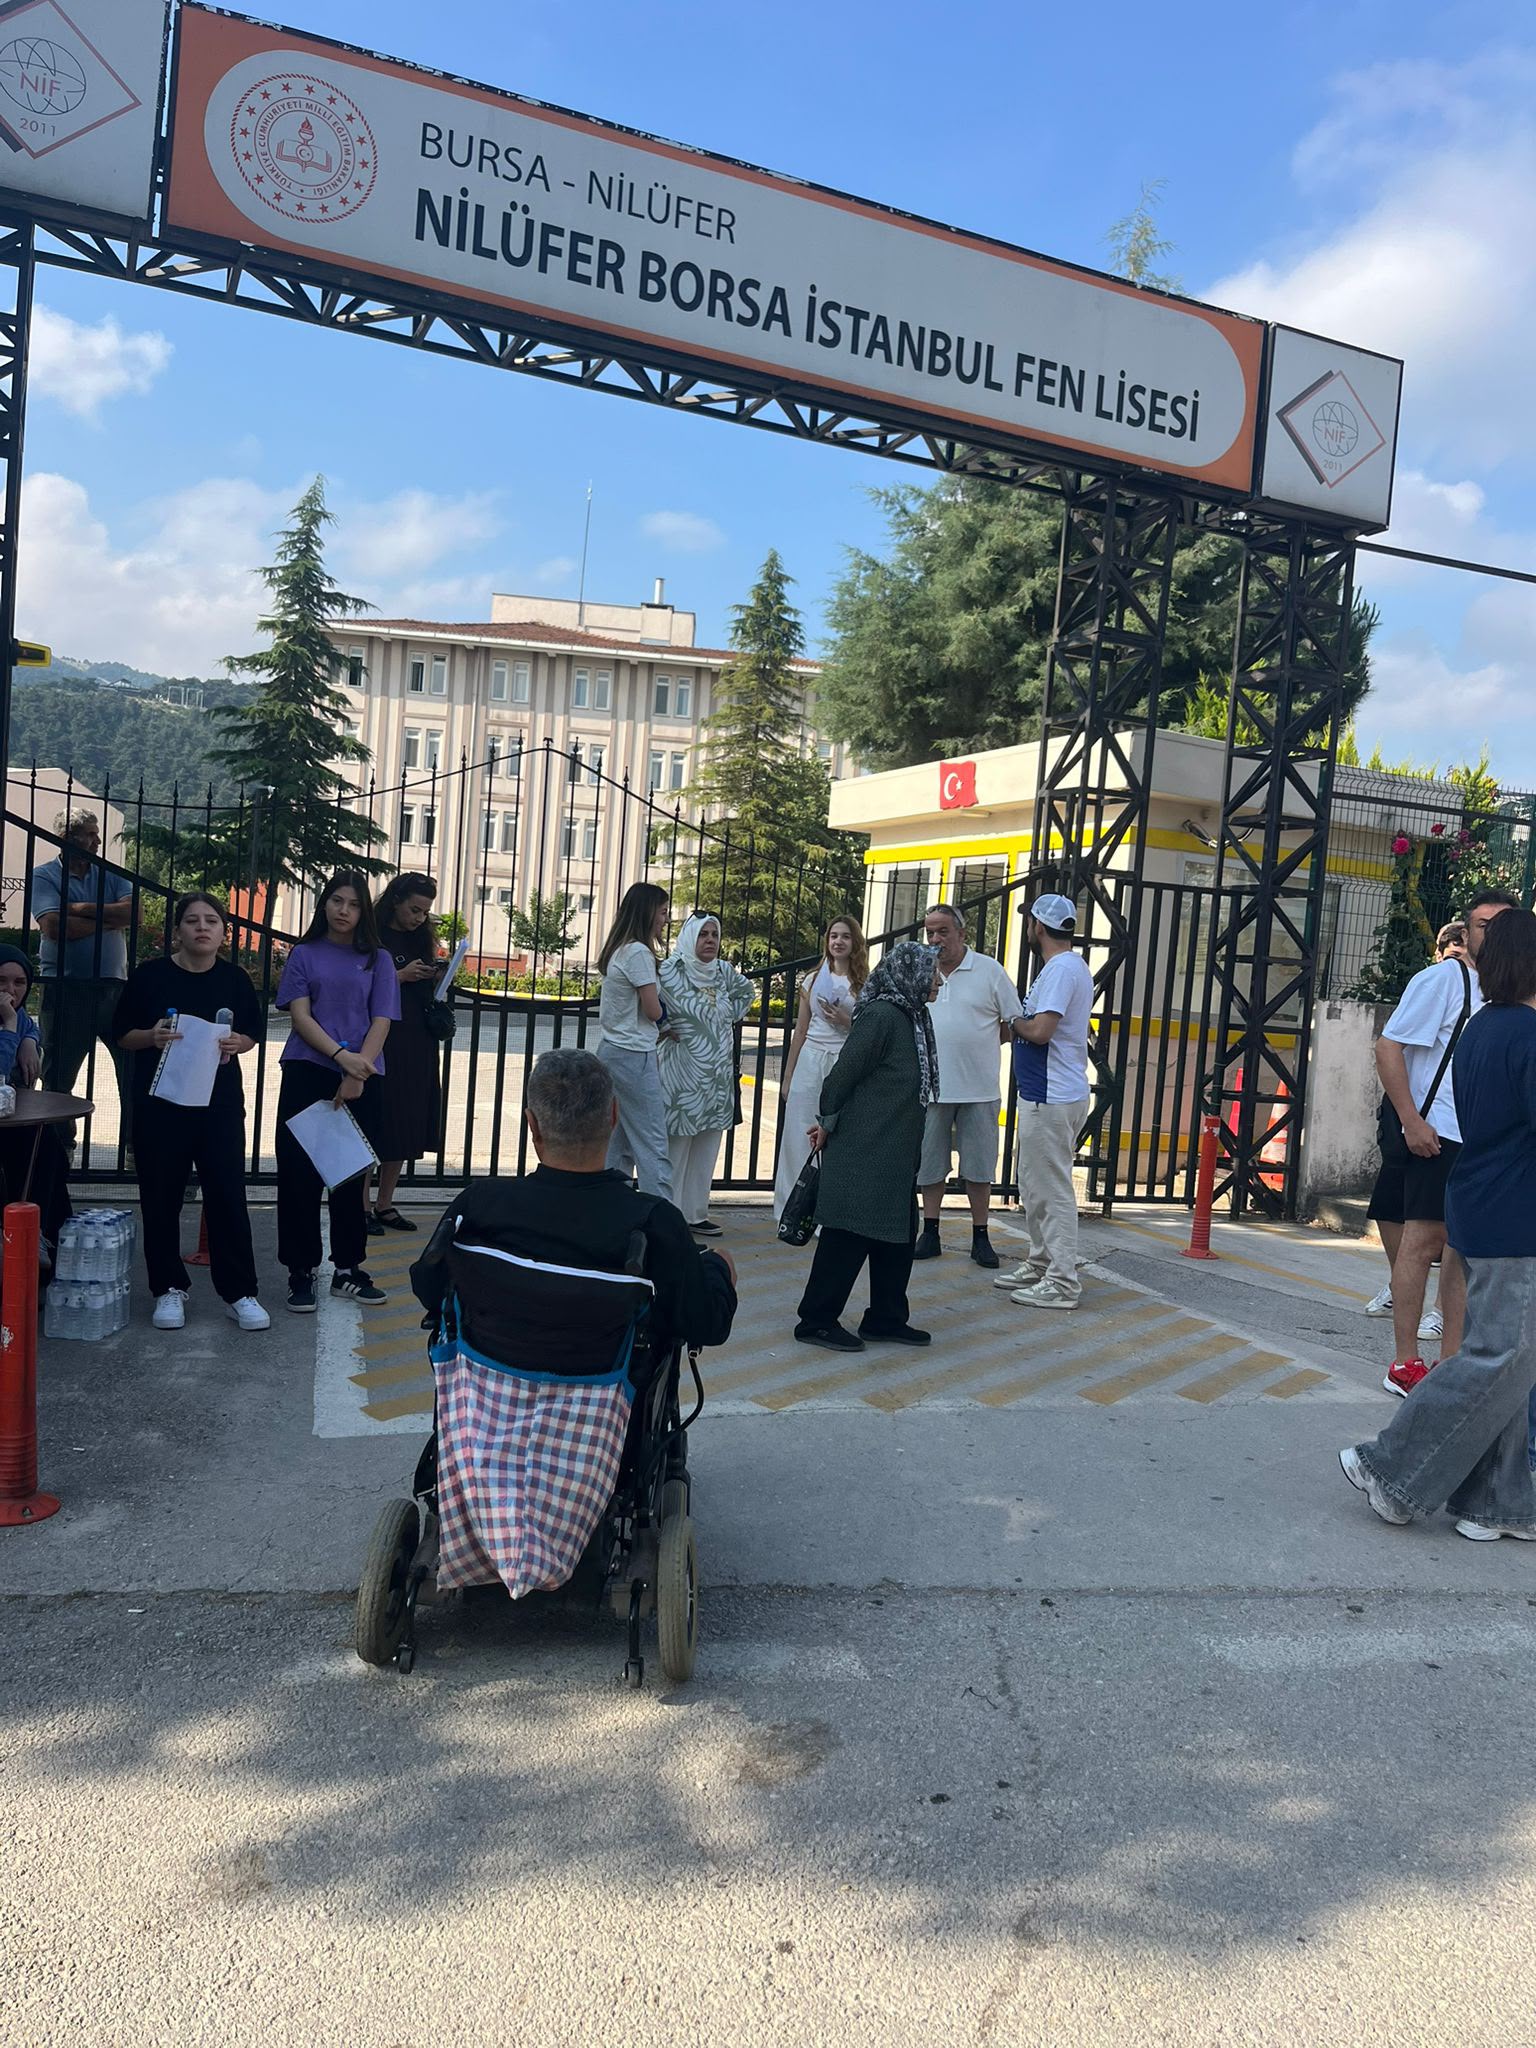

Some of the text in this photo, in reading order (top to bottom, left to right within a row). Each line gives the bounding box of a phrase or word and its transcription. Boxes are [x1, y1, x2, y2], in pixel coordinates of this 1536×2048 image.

[20, 72, 62, 97] NİF
[19, 117, 56, 137] 2011
[420, 122, 551, 193] BURSA
[587, 170, 736, 245] NİLÜFER
[414, 187, 1200, 442] NİLÜFER BORSA İSTANBUL FEN LİSESİ
[1323, 459, 1343, 472] 2011
